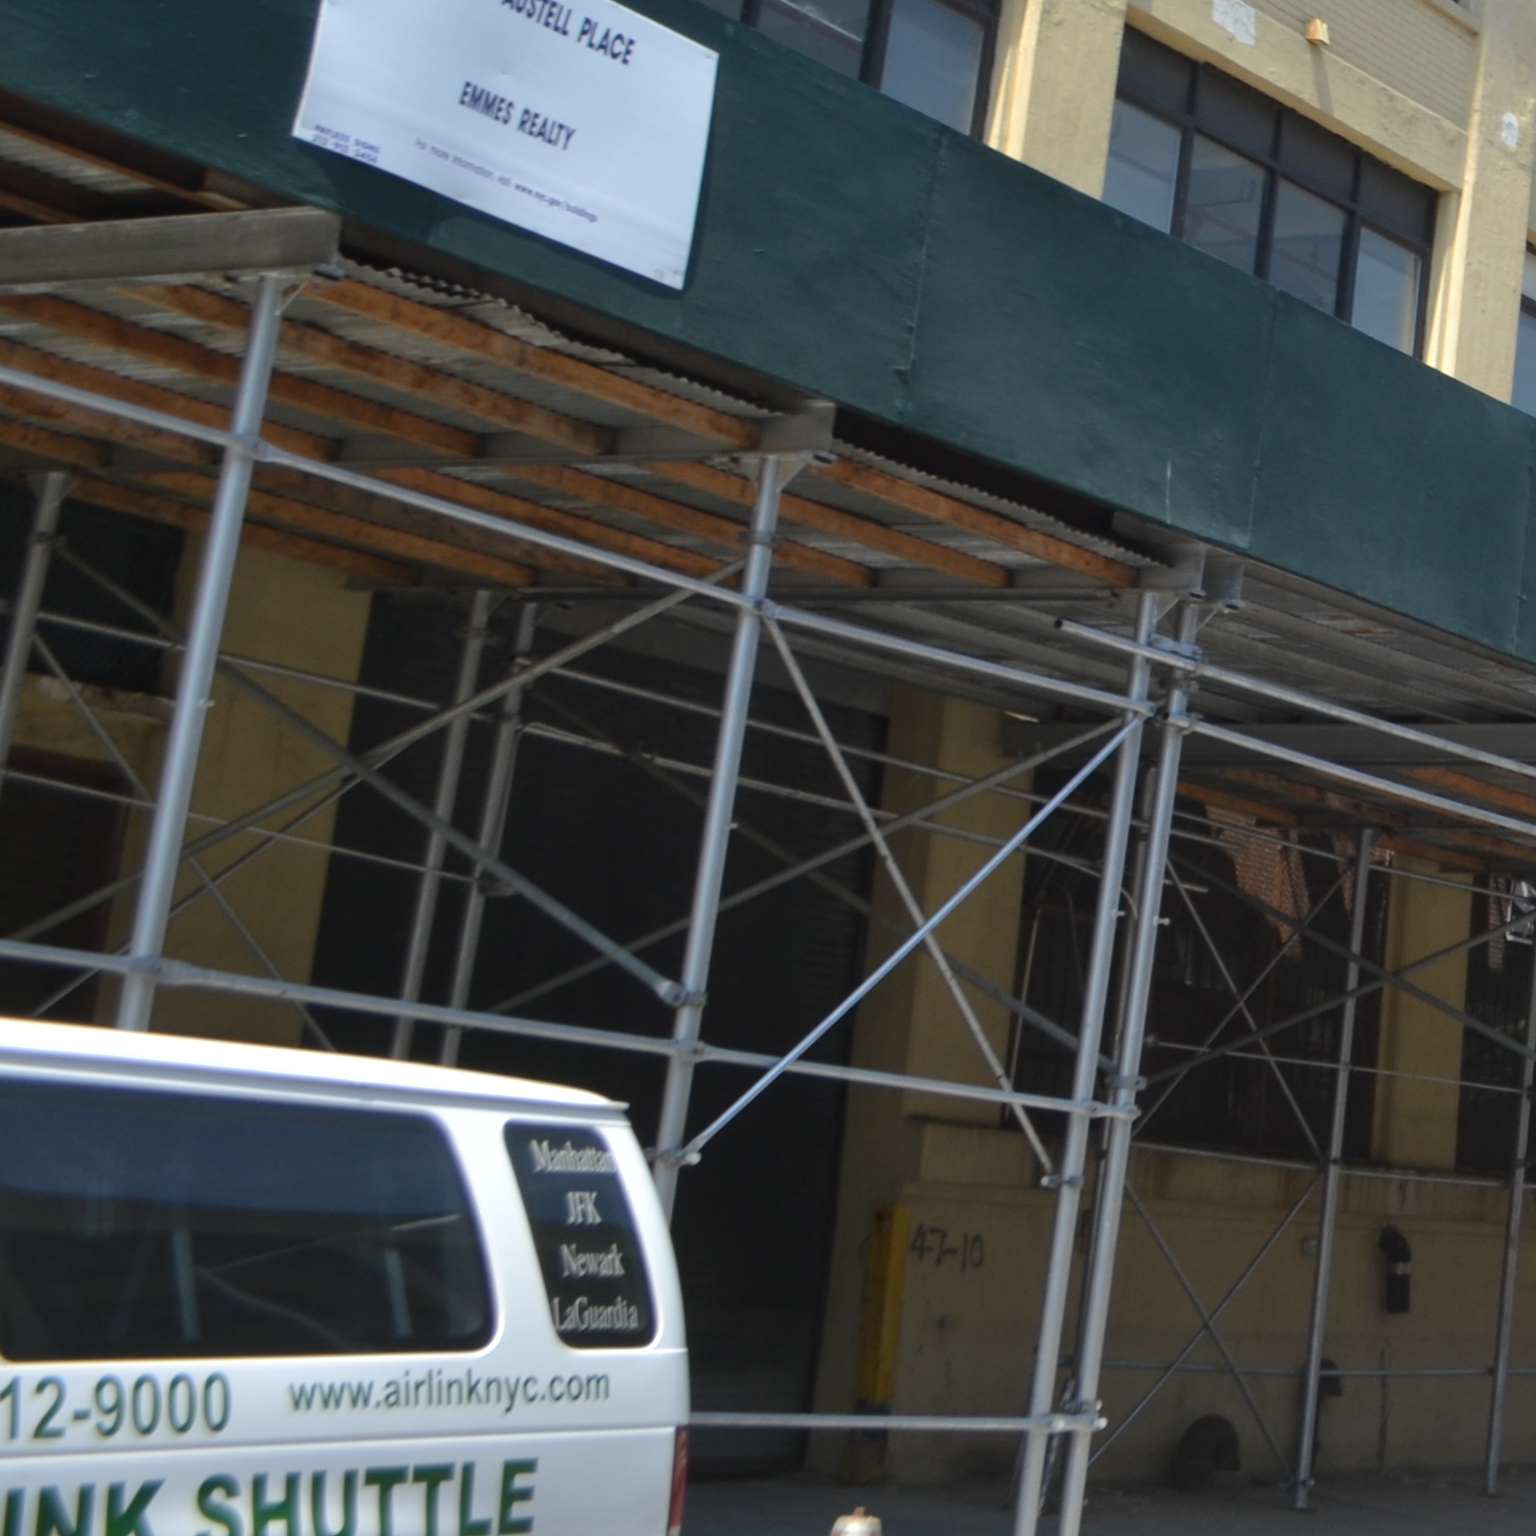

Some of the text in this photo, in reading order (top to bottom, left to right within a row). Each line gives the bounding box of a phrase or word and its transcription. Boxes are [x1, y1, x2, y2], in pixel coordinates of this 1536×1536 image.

[576, 17, 636, 66] PLACE
[459, 81, 577, 151] EMMES REALTY
[529, 1139, 617, 1174] Manhattan
[564, 1190, 603, 1226] JFK
[559, 1242, 626, 1279] Newark
[910, 1224, 986, 1273] 47-10
[551, 1296, 640, 1332] LaGuardia
[0, 1367, 612, 1441] 12-9000 www.airlinknyc.com
[196, 1457, 539, 1536] SHUTTLE
